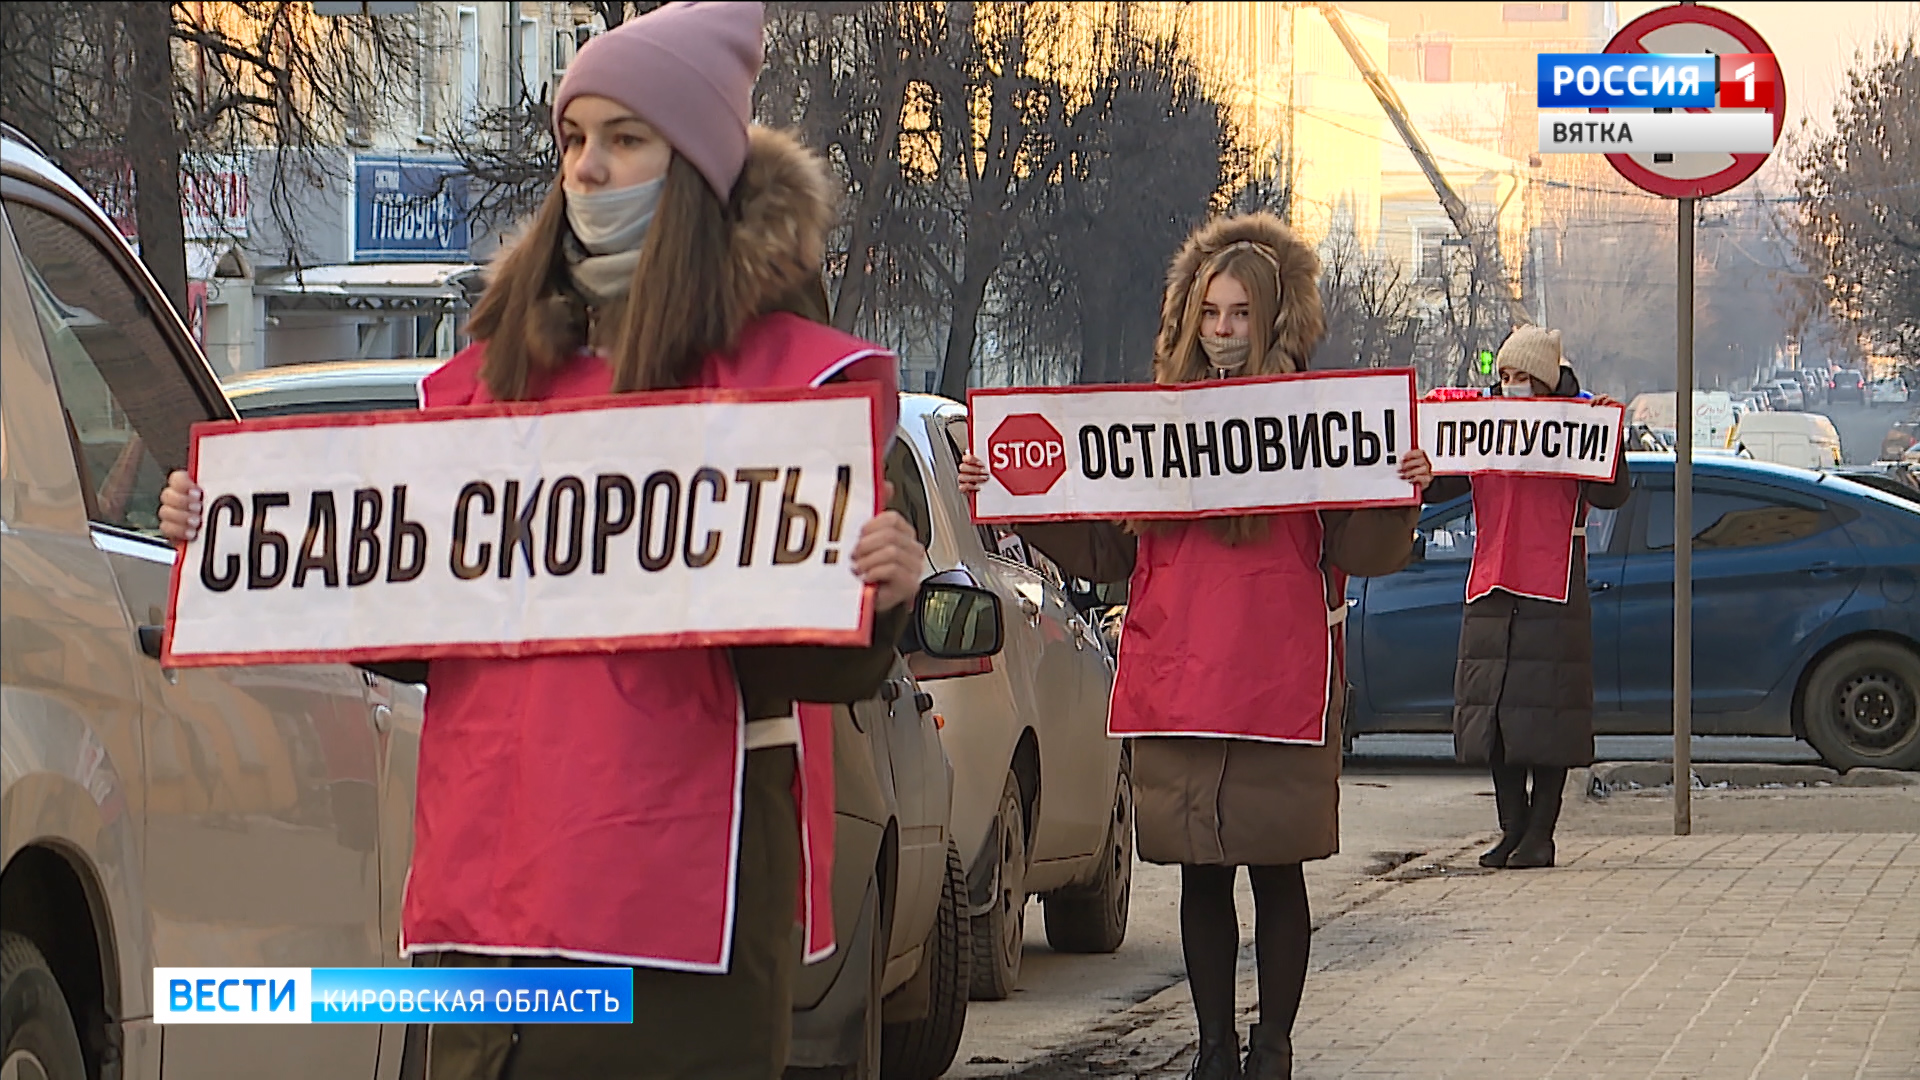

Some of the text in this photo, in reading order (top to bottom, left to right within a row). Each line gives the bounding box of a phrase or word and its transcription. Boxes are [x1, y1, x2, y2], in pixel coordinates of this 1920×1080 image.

[991, 440, 1064, 470] STOP
[1078, 408, 1398, 480] ОСТАНОВИСЬ!
[1435, 418, 1609, 462] ПРОПУСТИ!
[200, 465, 853, 593] СБАВЬ СКОРОСТЬ!
